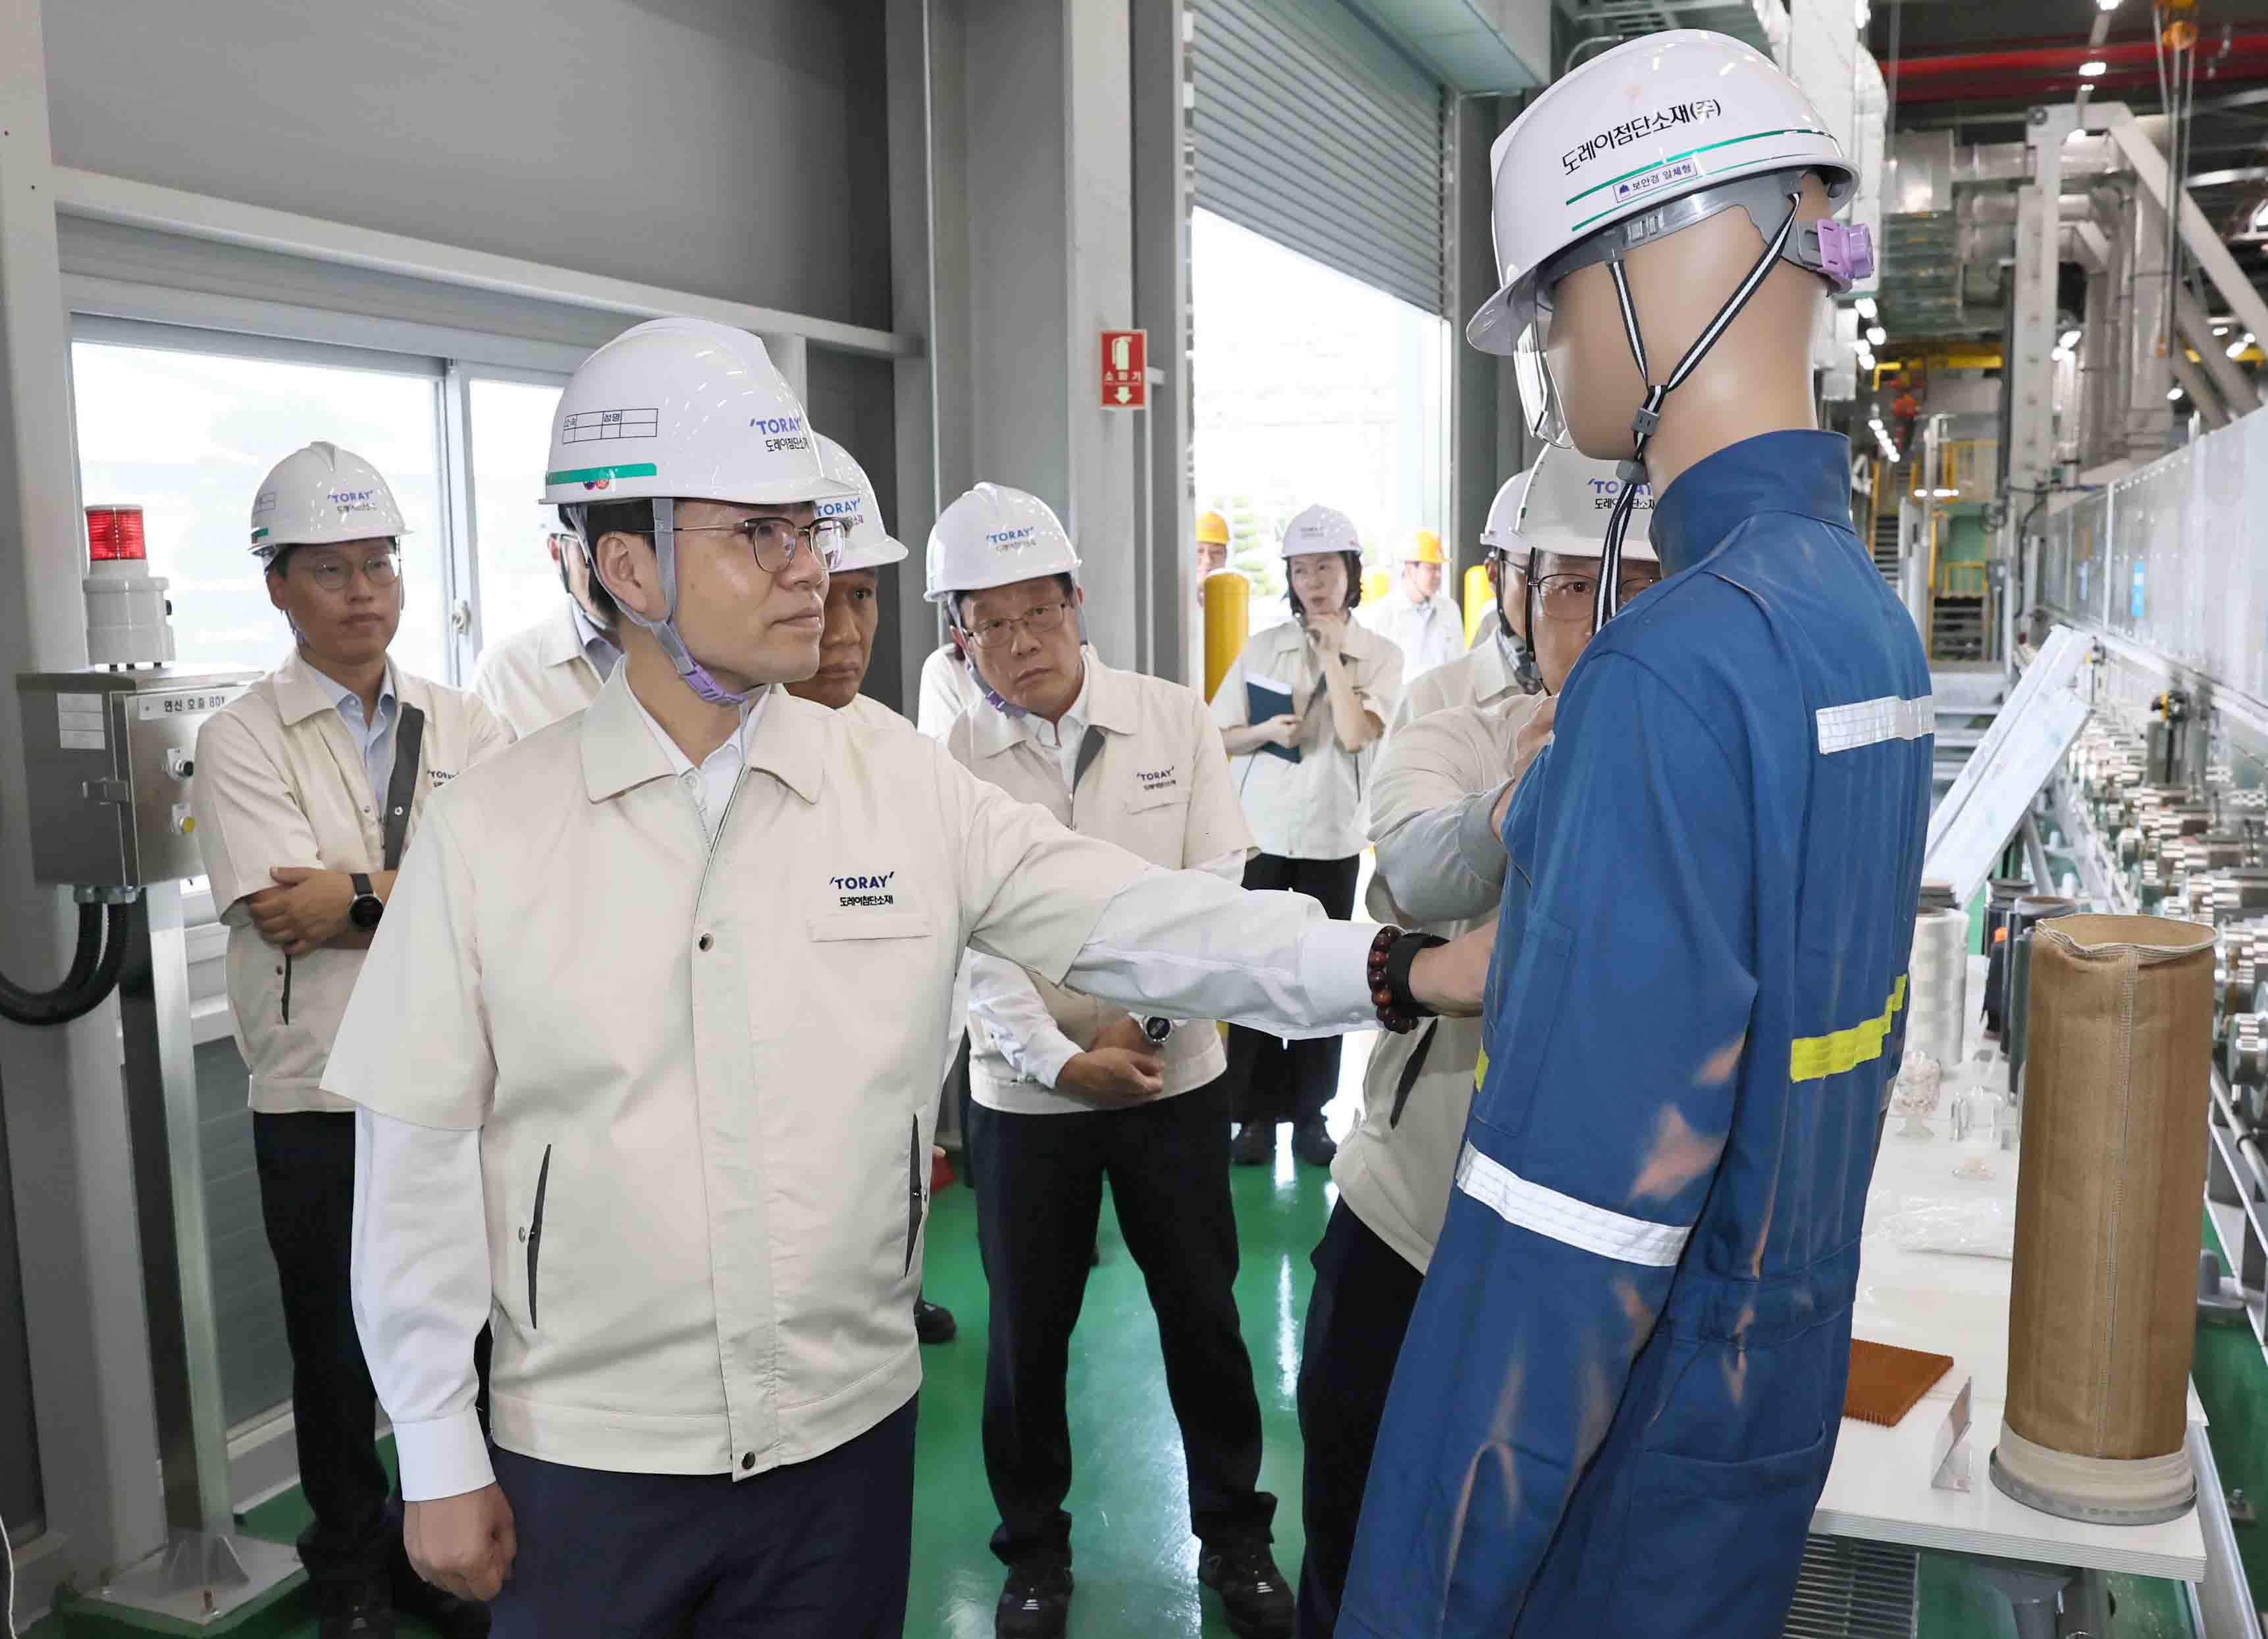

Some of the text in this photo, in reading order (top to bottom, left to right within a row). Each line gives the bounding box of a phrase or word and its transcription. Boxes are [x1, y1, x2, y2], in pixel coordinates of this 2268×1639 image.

[1562, 99, 1722, 176] 도레이첨단소재(주)
[1632, 163, 1692, 191] 보안경 일체형
[1105, 371, 1142, 381] 소기
[604, 413, 620, 423] 성명
[839, 895, 893, 906] 도레이첨단소재
